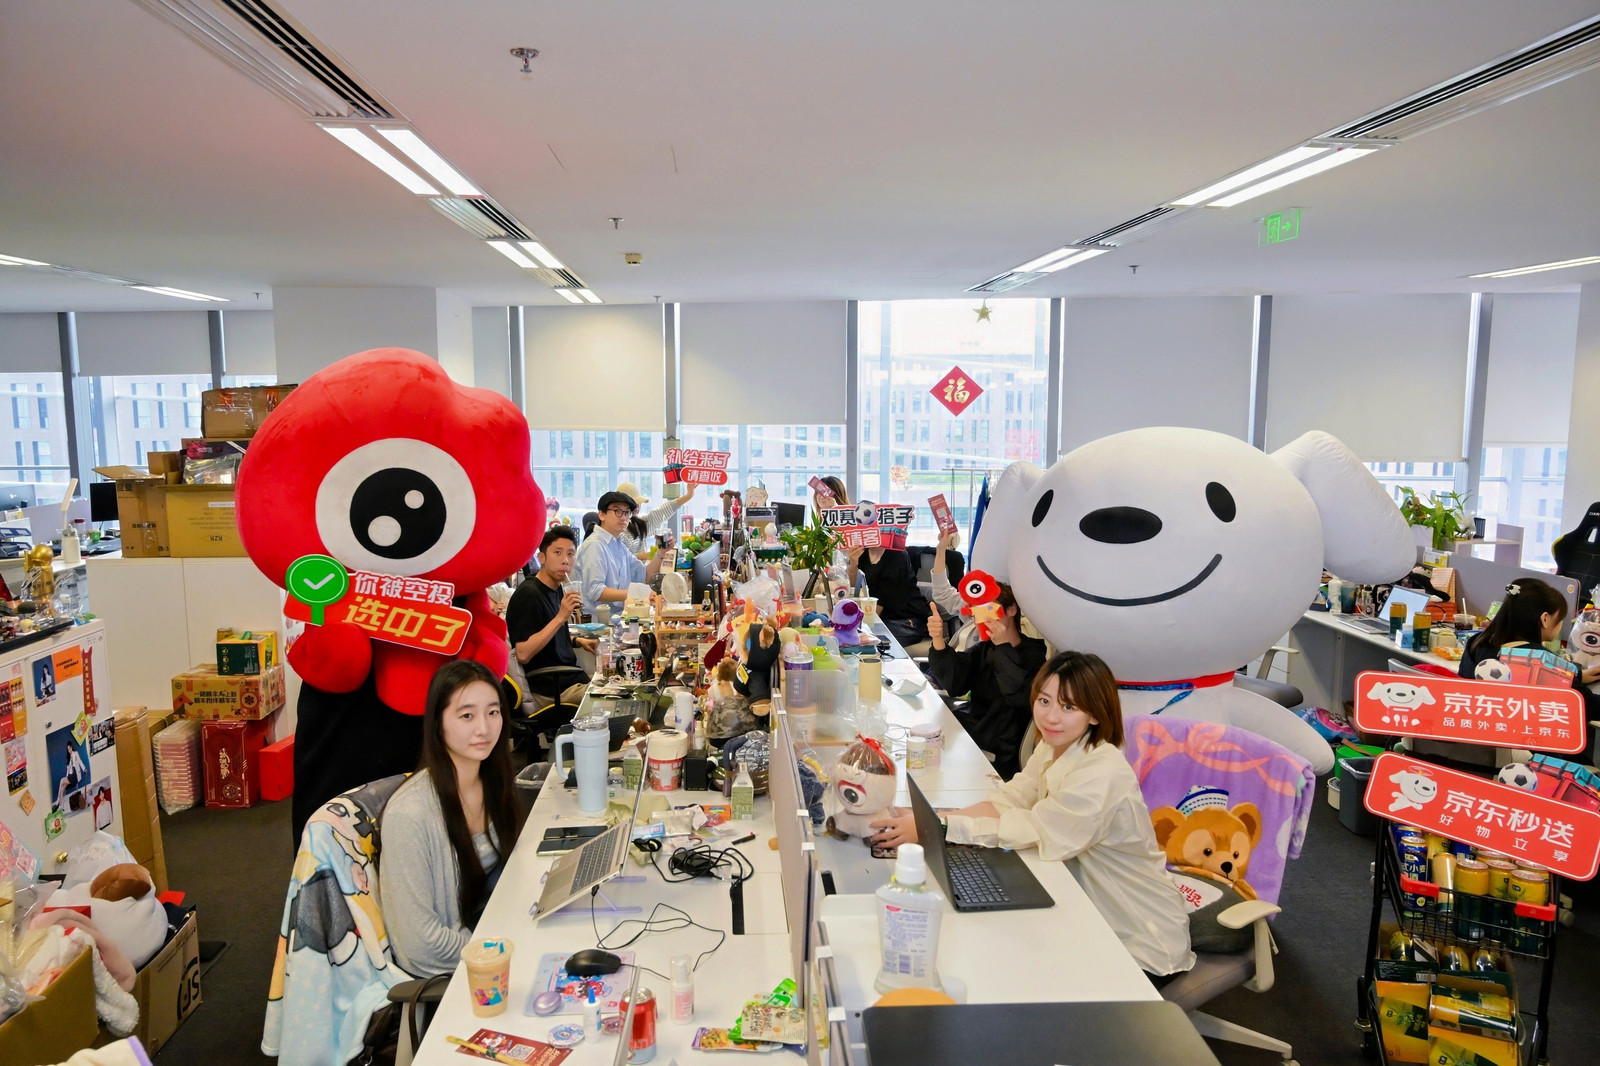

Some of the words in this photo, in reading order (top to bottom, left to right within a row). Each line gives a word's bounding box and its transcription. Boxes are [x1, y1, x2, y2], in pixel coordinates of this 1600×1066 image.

[943, 377, 970, 403] 福
[667, 449, 730, 468] 补给来了
[687, 470, 722, 483] 请查收
[822, 509, 856, 526] 观赛
[877, 507, 913, 525] 搭子
[354, 573, 454, 606] 你被空投
[341, 596, 466, 648] 选中了
[1443, 692, 1570, 725] 京东外卖
[1443, 789, 1575, 849] 京东秒送
[1439, 813, 1570, 862] 好物立享
